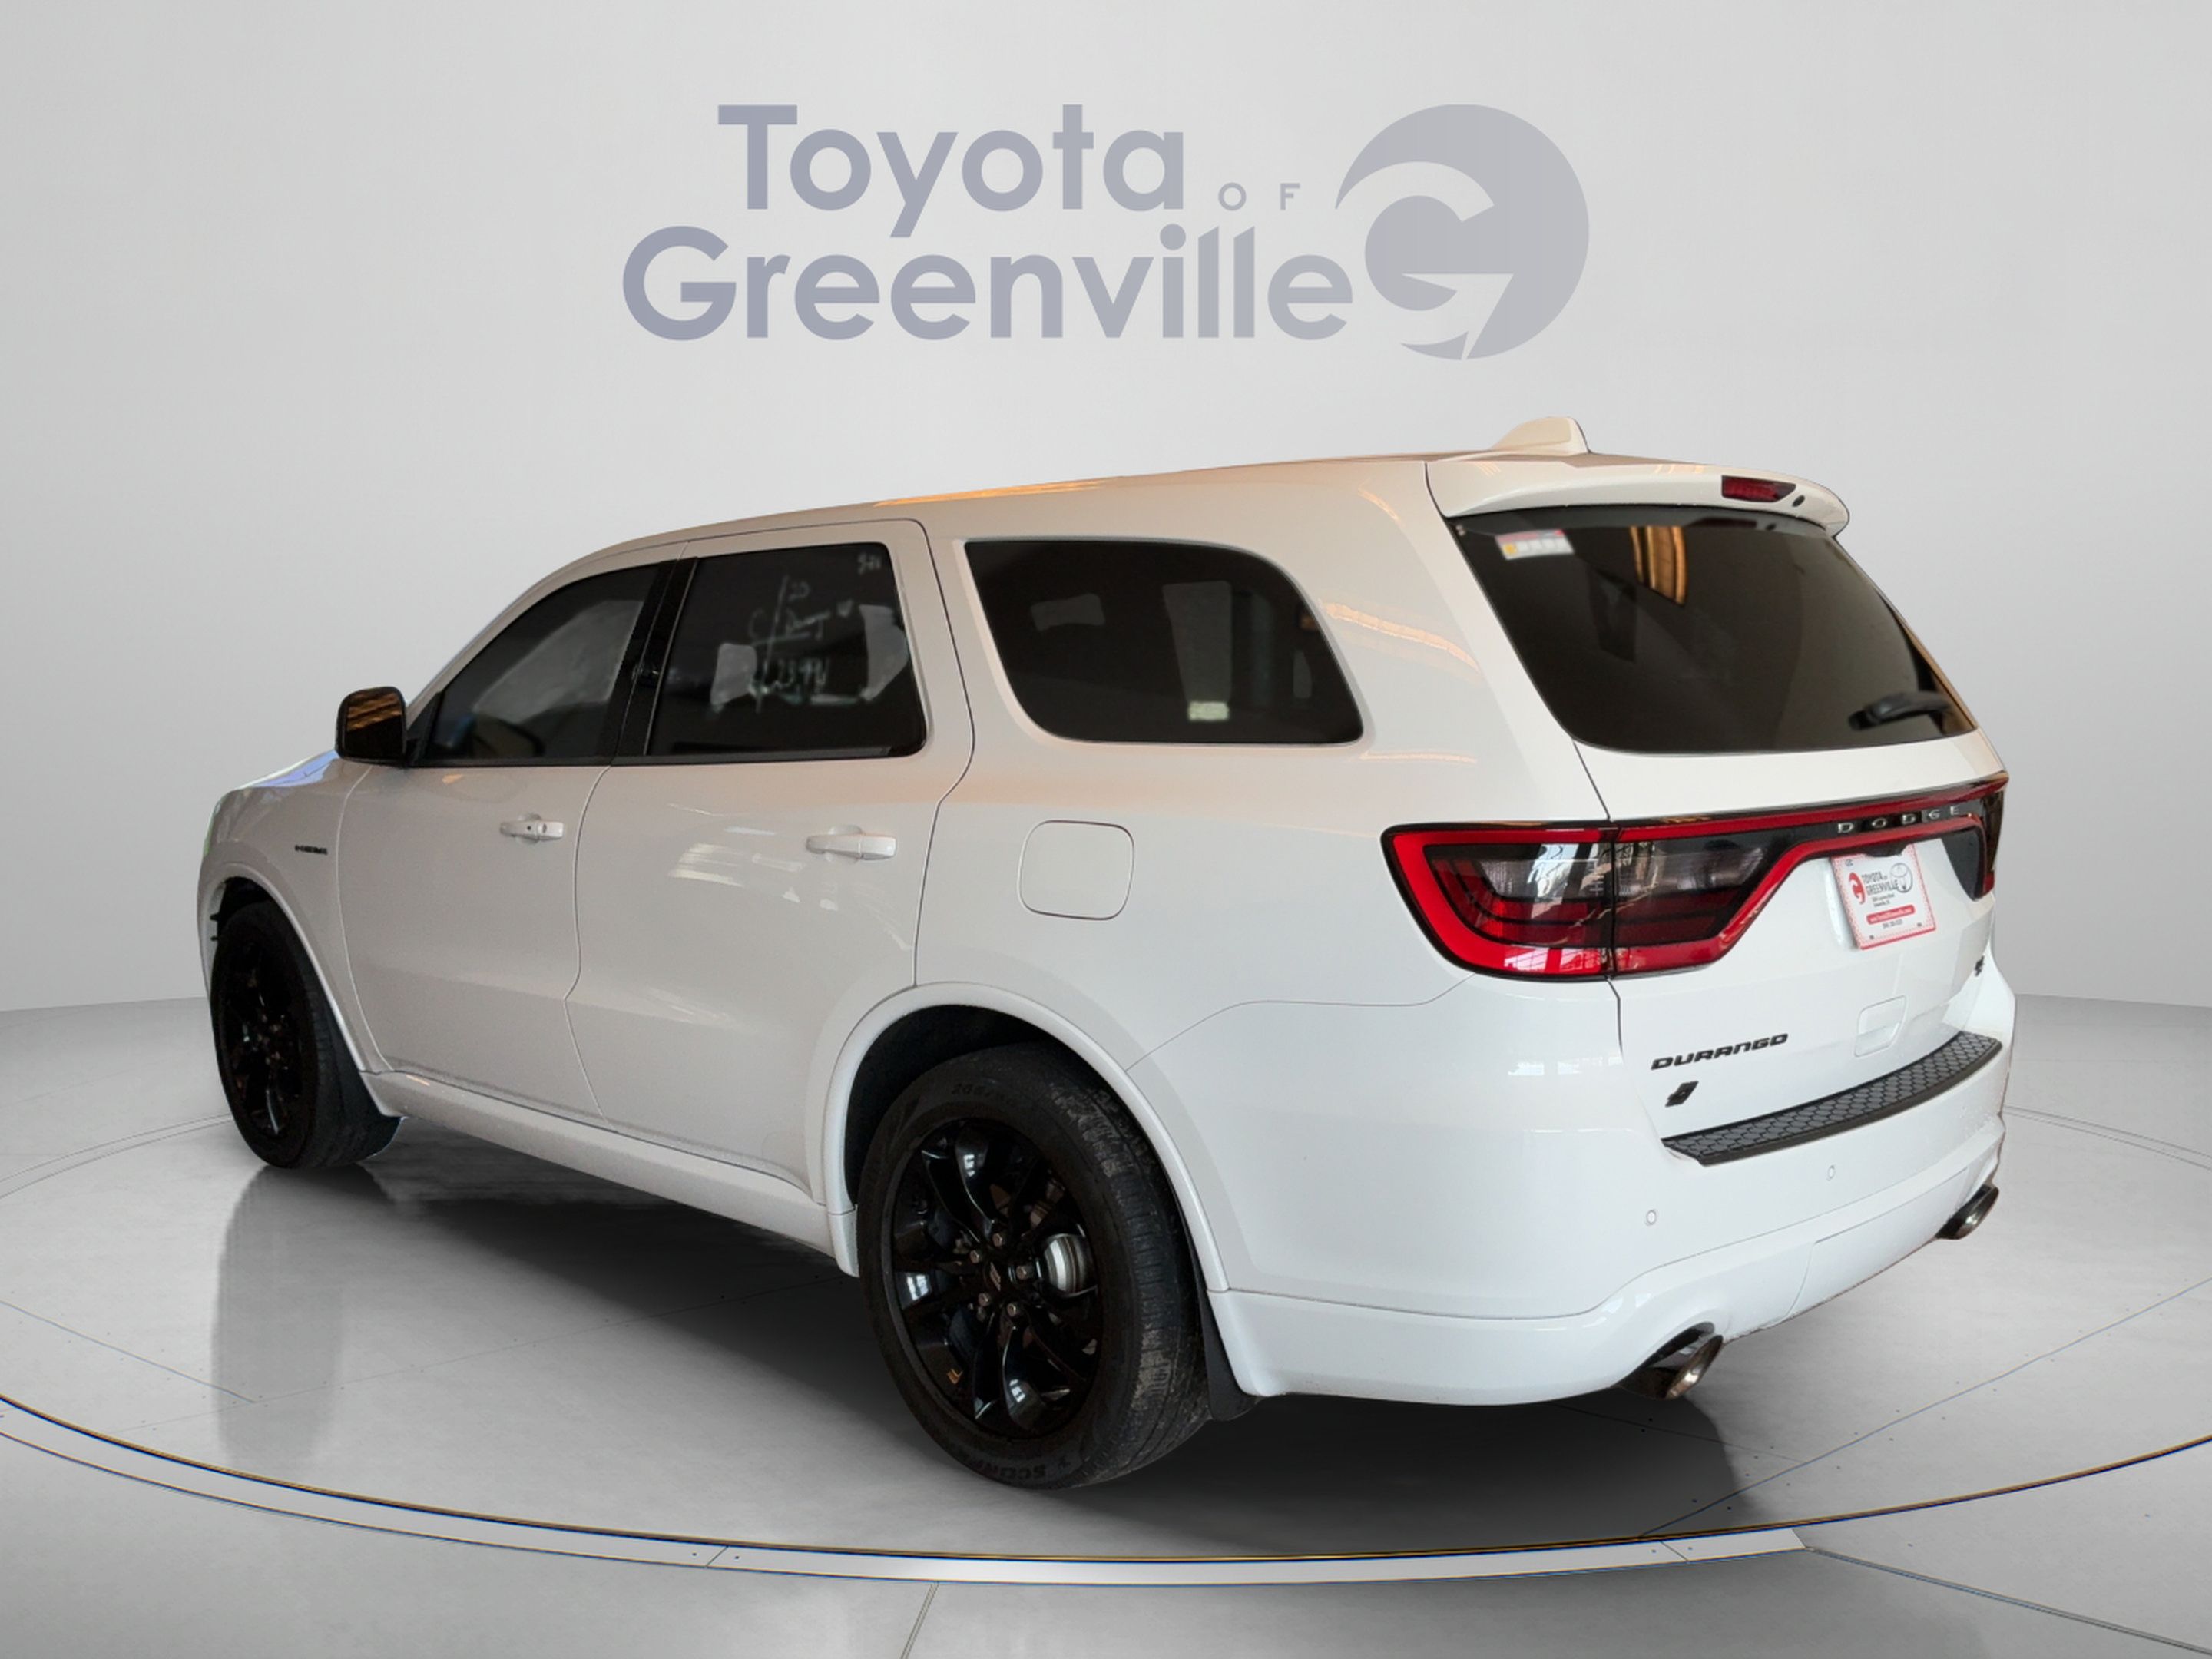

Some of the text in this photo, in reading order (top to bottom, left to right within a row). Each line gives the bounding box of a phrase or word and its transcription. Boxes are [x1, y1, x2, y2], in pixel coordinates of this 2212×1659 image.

[717, 104, 1184, 238] Toyota
[622, 223, 1354, 341] Greenville
[1837, 806, 1959, 834] DODGE
[1651, 1033, 1789, 1071] DURANGO
